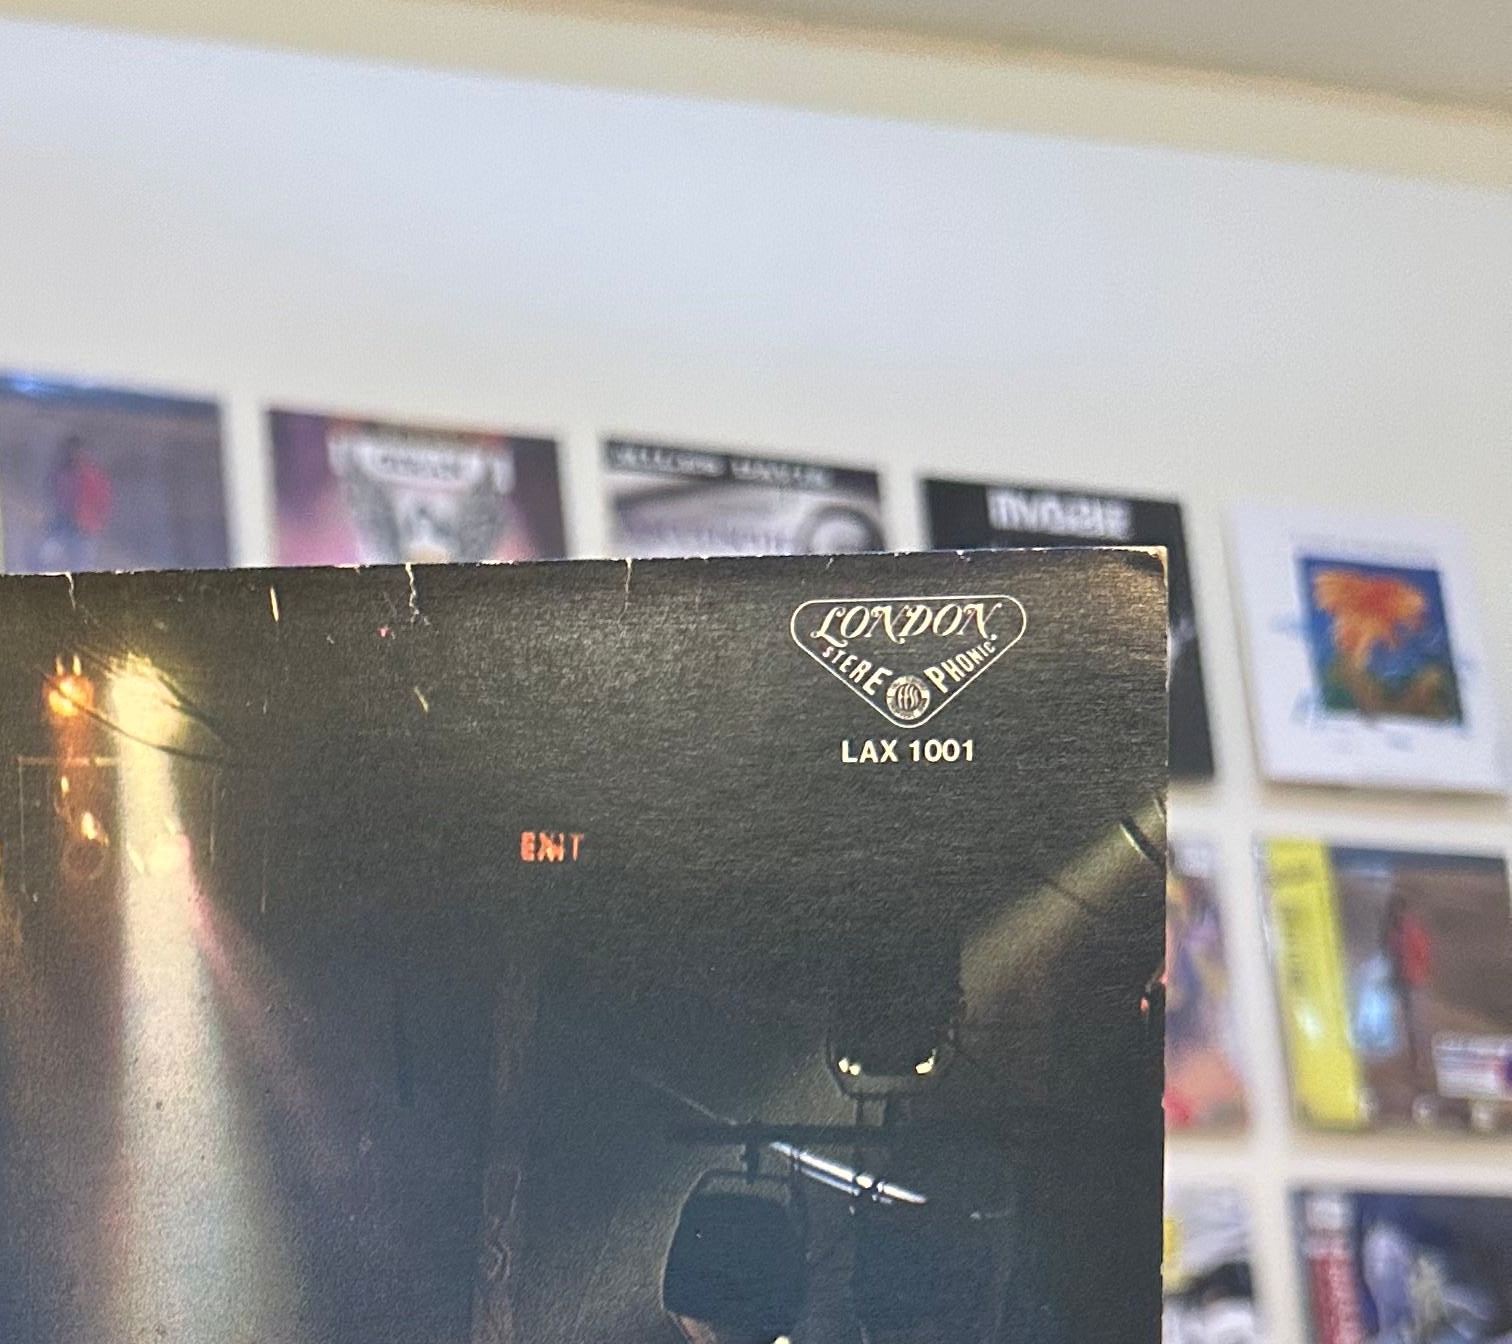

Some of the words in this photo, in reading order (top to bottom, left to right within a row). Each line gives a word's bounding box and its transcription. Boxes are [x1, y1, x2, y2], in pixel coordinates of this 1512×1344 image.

[810, 601, 1003, 648] LONDON
[840, 739, 899, 764] LAX
[908, 738, 976, 763] 1001
